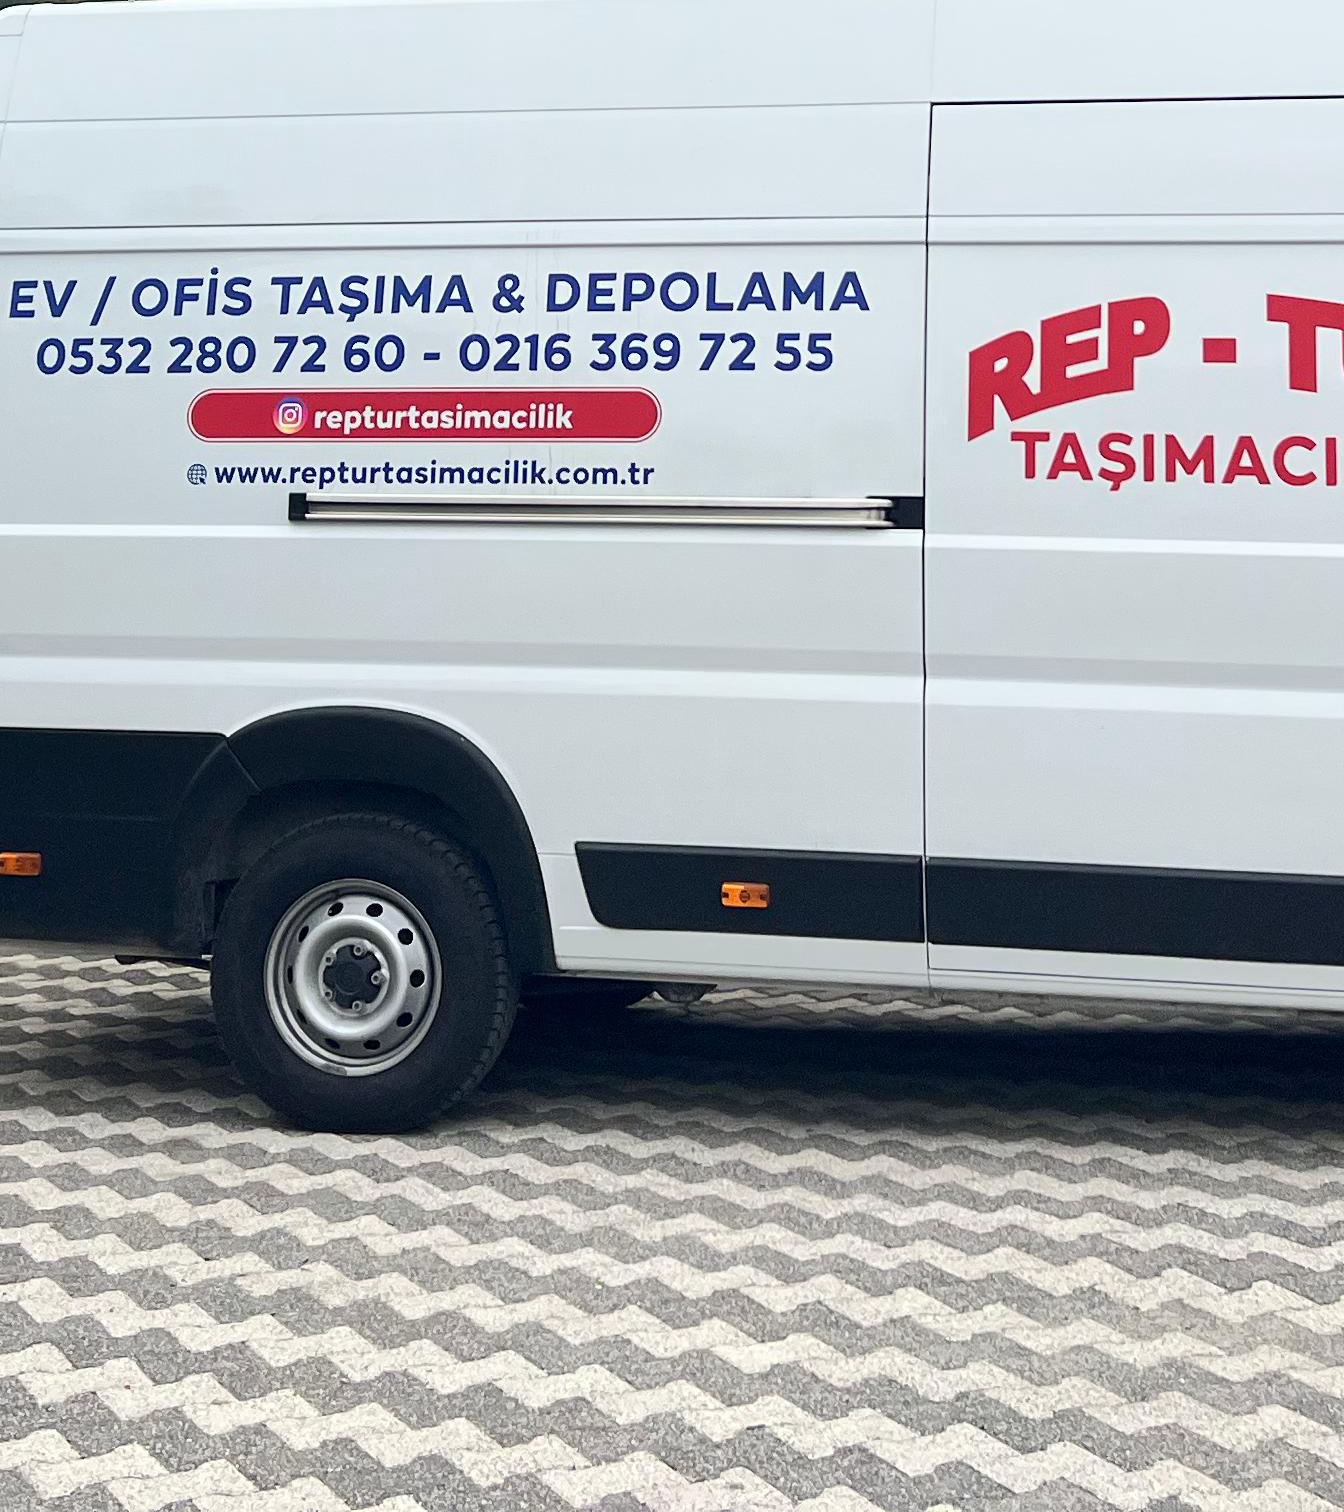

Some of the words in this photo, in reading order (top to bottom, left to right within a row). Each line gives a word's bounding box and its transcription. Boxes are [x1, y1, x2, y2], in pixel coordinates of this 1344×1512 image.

[8, 278, 78, 319] EV
[89, 274, 117, 327] /
[131, 265, 253, 318] OFİS
[270, 273, 474, 324] TAŞIMA
[492, 273, 525, 314] &
[546, 270, 870, 313] DEPOLAMA
[36, 336, 152, 376] 0532
[166, 335, 257, 374] 280
[272, 334, 327, 374] 72
[343, 334, 406, 373] 60
[422, 351, 441, 362] -
[459, 332, 572, 373] 0216
[589, 332, 681, 372] 369
[699, 331, 756, 372] 72
[773, 331, 833, 372] 55
[966, 295, 1173, 442] REP
[1202, 337, 1238, 365] -
[313, 401, 574, 436] repturtasimacilik
[214, 459, 656, 491] www.repturtasimacilik.com.tr
